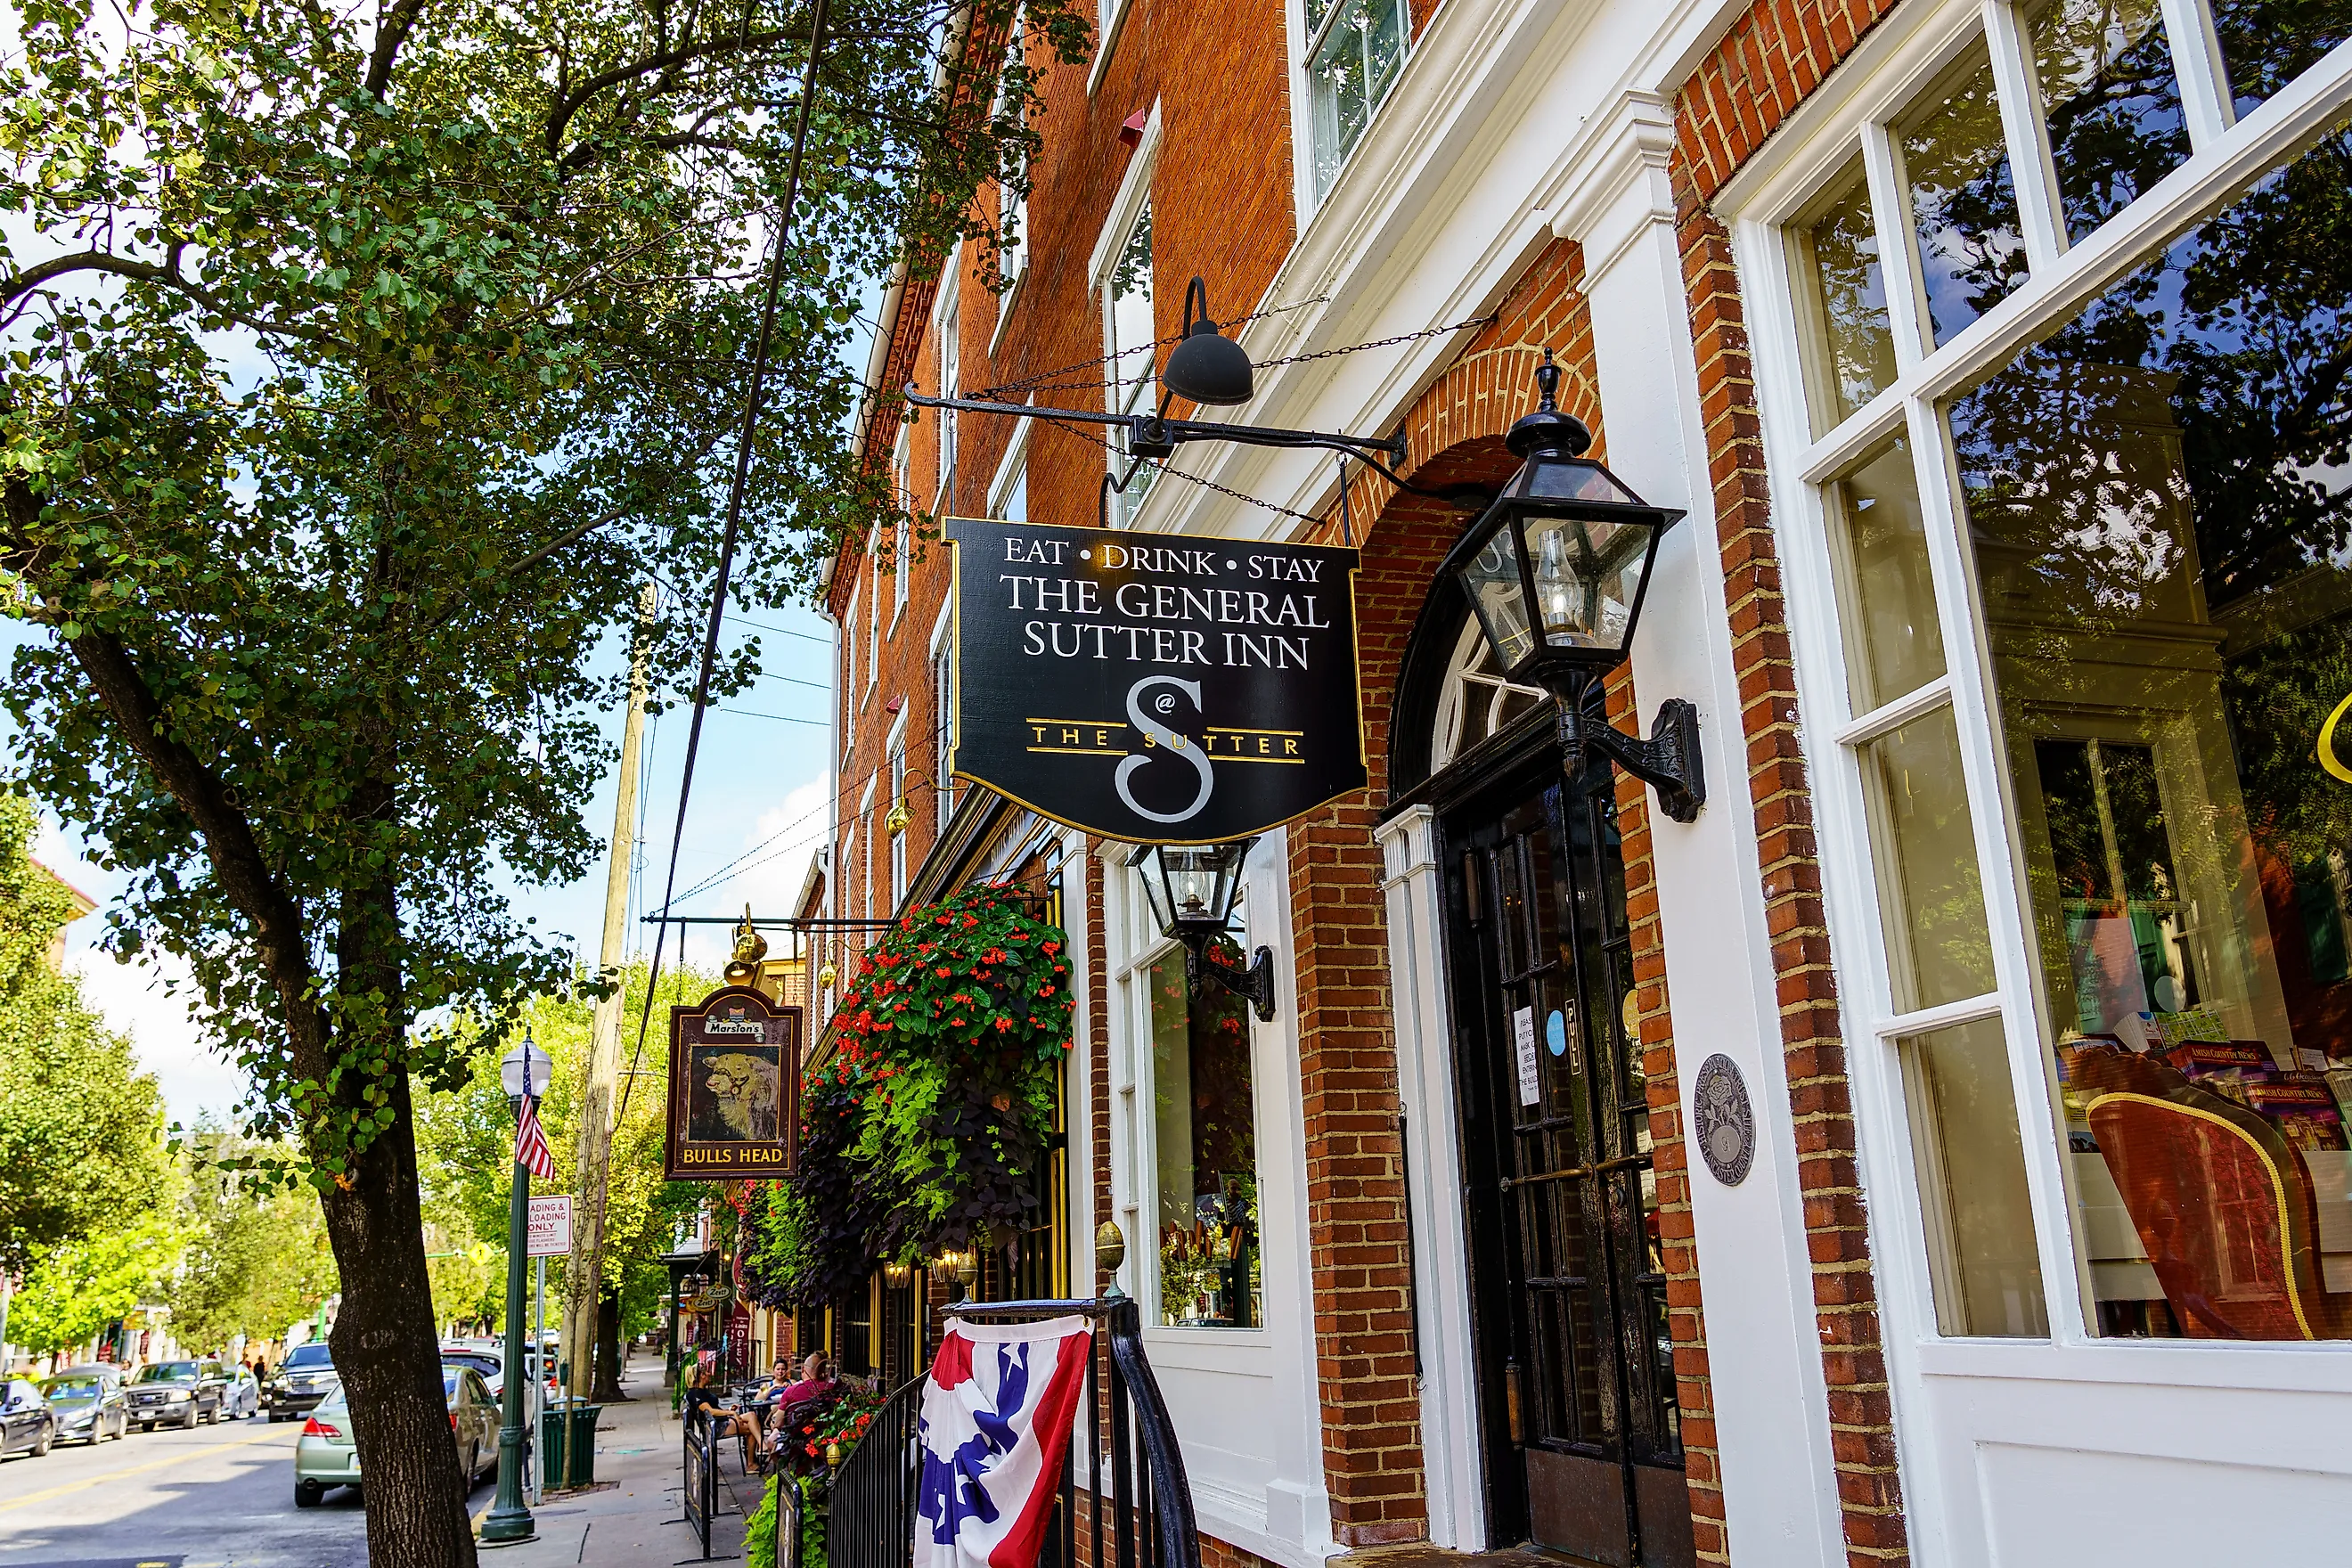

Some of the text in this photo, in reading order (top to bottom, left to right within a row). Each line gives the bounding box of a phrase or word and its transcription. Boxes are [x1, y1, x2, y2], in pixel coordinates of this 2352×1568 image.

[1004, 537, 1324, 583] EAT DRINK STAY
[1000, 574, 1330, 629] THE GENERAL
[1024, 621, 1310, 670] SUTTER INN
[1031, 726, 1298, 755] THE SUTTER
[710, 1024, 759, 1033] Marston's
[1568, 1008, 1579, 1066] PULL
[2191, 1047, 2210, 1058] AMISH
[2210, 1049, 2237, 1059] COUNTRY
[2237, 1050, 2256, 1060] NEWS
[2257, 1087, 2324, 1098] AMISH COUNTRY NEWS
[1695, 1098, 1706, 1147] HISTORIC
[683, 1148, 783, 1164] BULLS HEAD
[1703, 1148, 1735, 1182] LANCASTER
[1735, 1139, 1752, 1179] COUNTY
[529, 1213, 566, 1221] LOADING
[530, 1204, 556, 1212] ADING
[527, 1222, 554, 1231] ONLY
